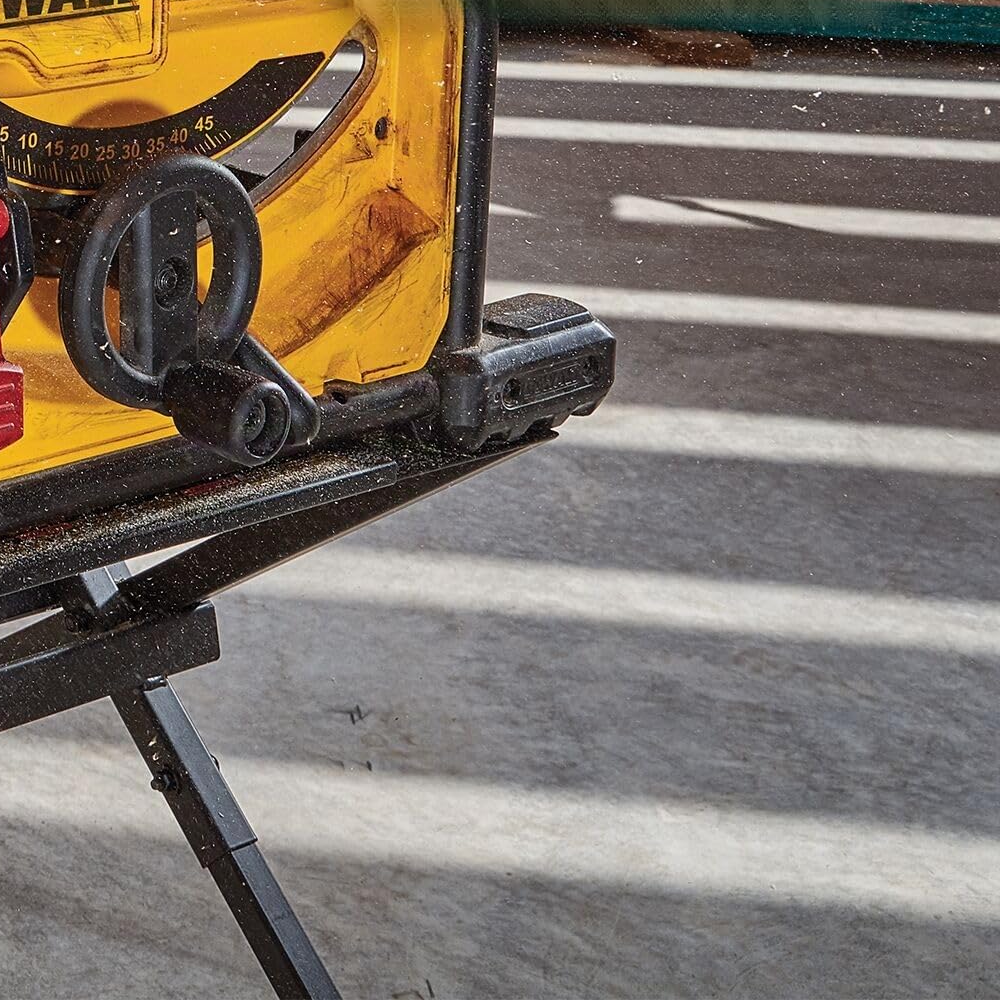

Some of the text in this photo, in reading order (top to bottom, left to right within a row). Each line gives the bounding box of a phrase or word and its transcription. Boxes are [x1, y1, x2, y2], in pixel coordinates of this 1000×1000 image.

[0, 115, 214, 161] 5 10 15 20 25 30 35 40 45
